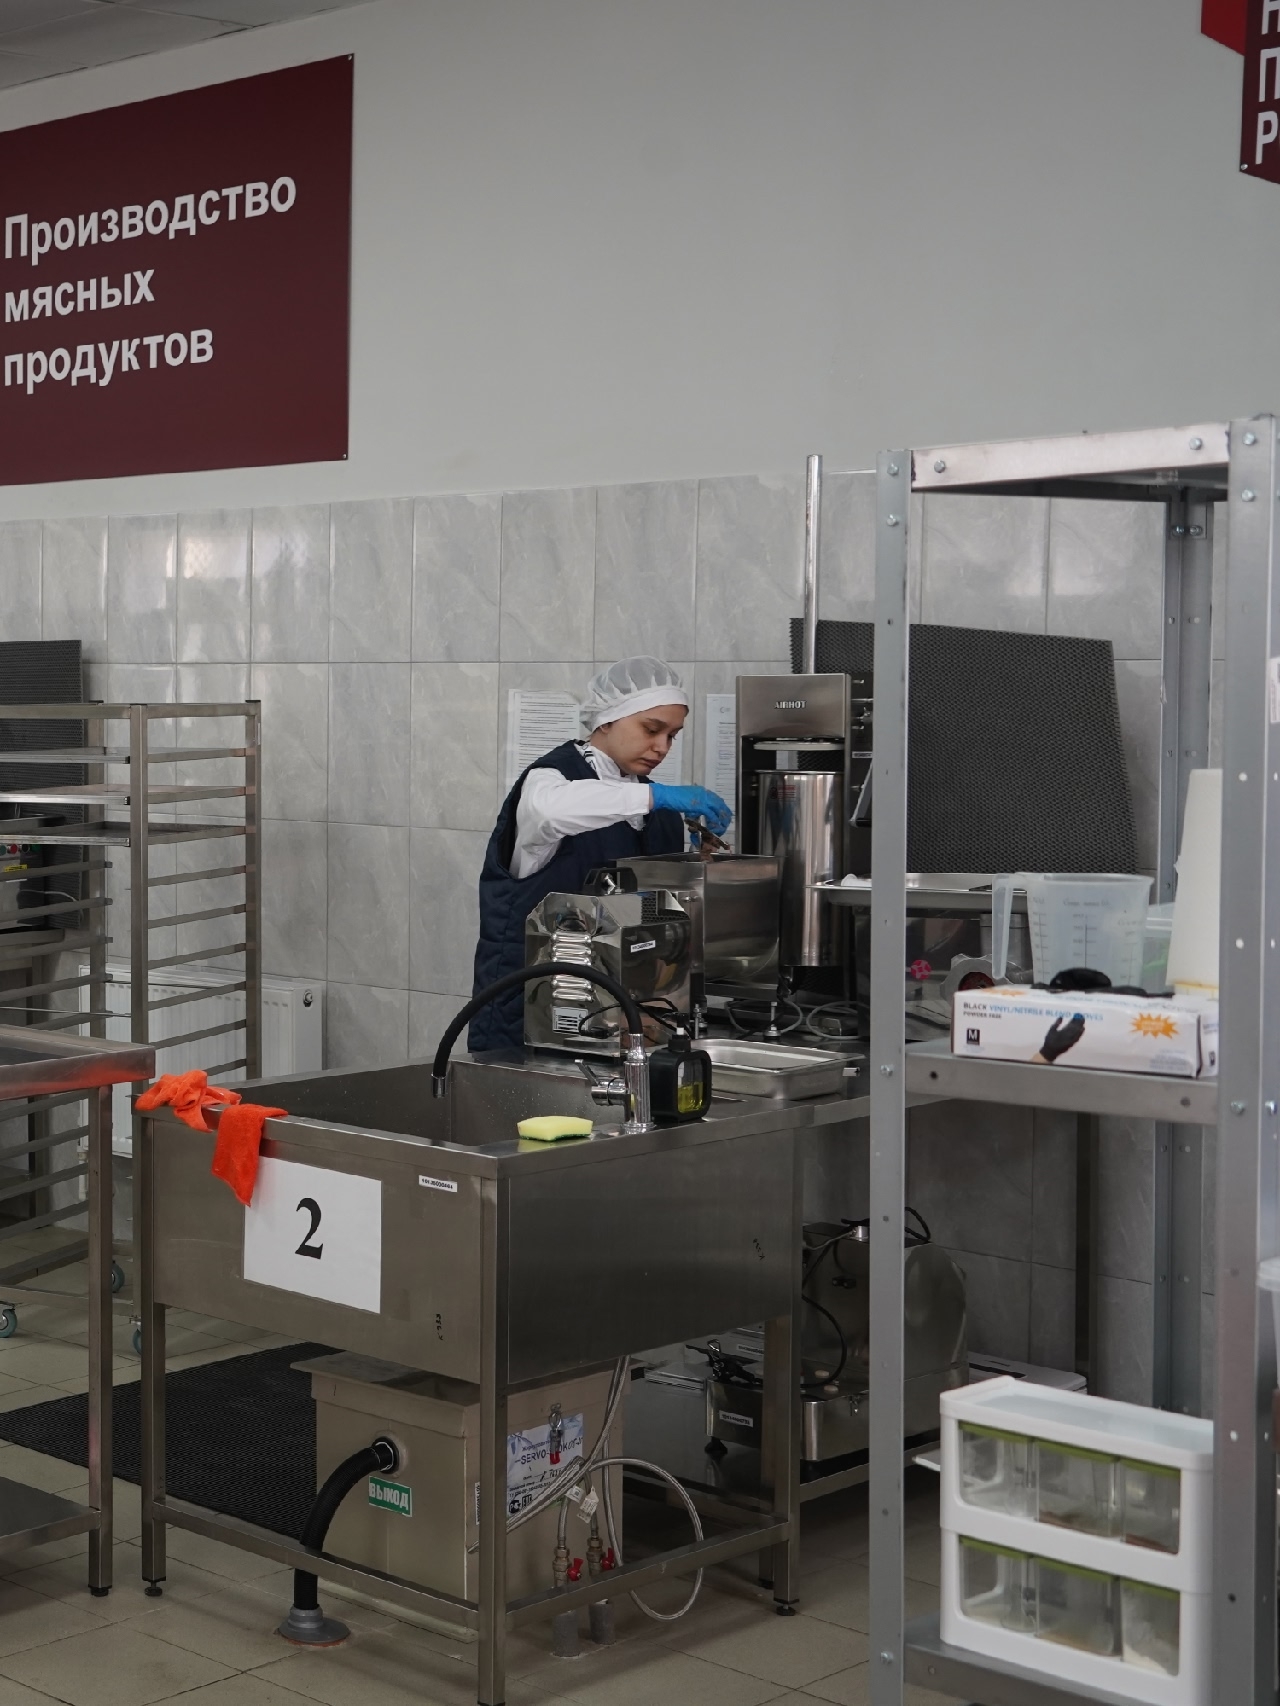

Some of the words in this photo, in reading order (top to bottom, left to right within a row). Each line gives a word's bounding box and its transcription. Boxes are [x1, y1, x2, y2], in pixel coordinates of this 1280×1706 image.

[1255, 110, 1280, 165] Р
[4, 175, 297, 266] Производство
[4, 269, 156, 323] мясных
[4, 328, 214, 395] продуктов
[774, 700, 807, 709] AIRHOT
[963, 1002, 987, 1011] BLACK
[295, 1197, 324, 1260] 2
[369, 1482, 409, 1511] ВЫХОД
